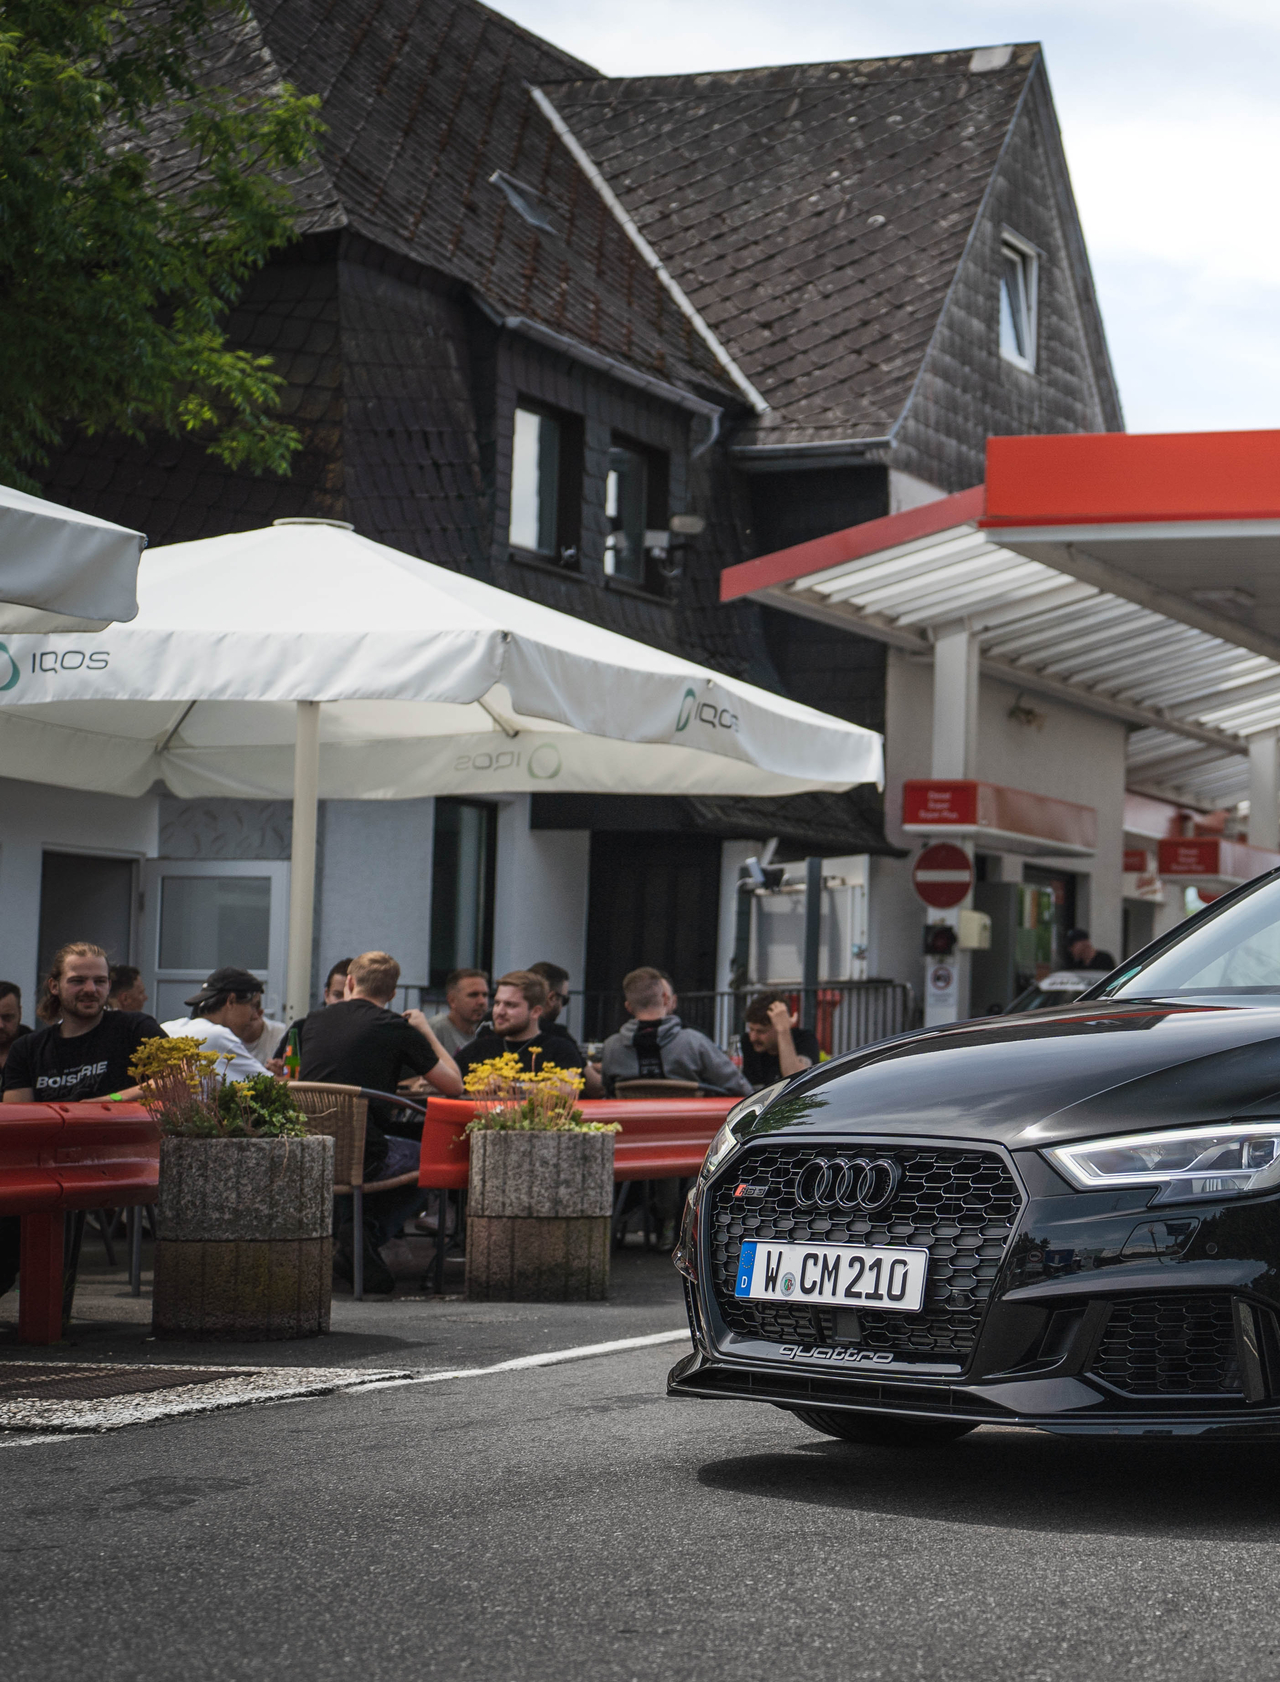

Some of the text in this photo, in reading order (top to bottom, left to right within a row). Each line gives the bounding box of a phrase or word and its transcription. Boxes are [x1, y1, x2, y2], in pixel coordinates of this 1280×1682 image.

[31, 650, 110, 674] IQOS
[740, 1275, 748, 1288] D
[764, 1250, 909, 1301] W CM 210
[779, 1344, 894, 1364] quattro
